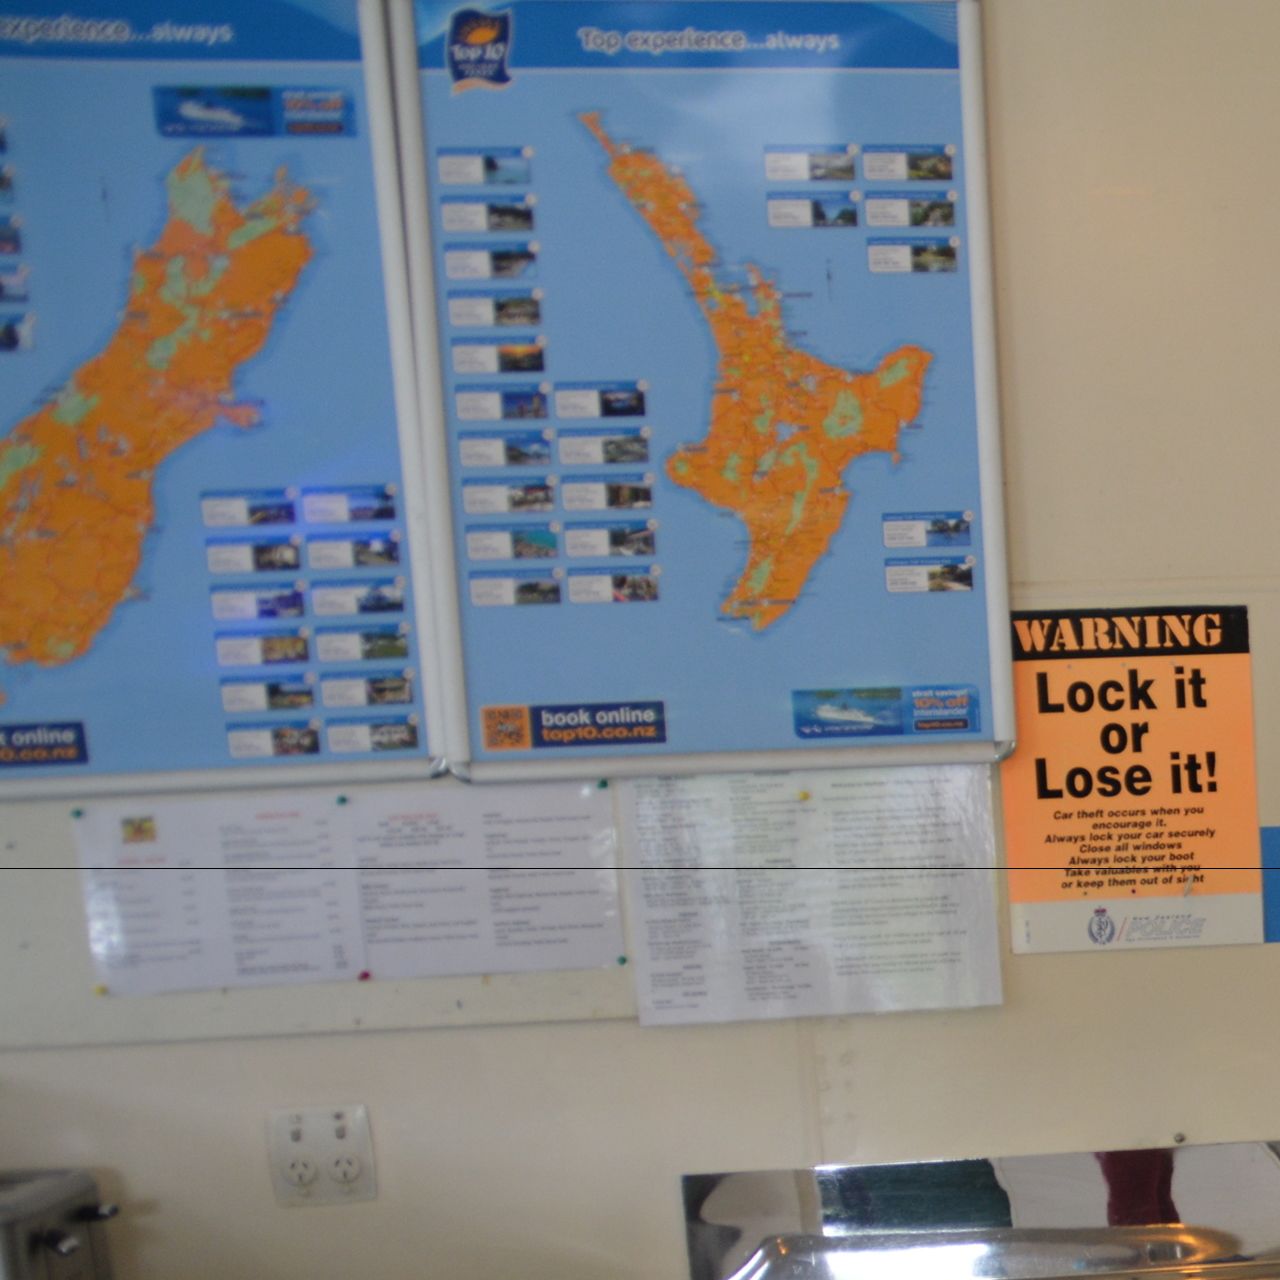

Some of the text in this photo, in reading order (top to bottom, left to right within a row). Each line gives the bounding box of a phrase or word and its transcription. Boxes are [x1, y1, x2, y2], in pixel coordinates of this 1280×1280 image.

[577, 26, 620, 54] Top
[1013, 613, 1222, 652] WARNING
[1036, 666, 1207, 714] Lock it
[541, 707, 656, 726] book online
[12, 727, 75, 746] online
[542, 725, 657, 743] top10.co.nz
[1100, 721, 1149, 755] or
[1035, 751, 1217, 799] Lose it!
[1053, 806, 1205, 820] Car theft occurs when you
[1091, 818, 1167, 830] encourage it.
[1044, 828, 1215, 844] Always lock your car securely
[1079, 841, 1182, 853] Close all windows
[1069, 852, 1195, 866] Always lock your boot
[1064, 864, 1201, 877] Take valuables with you
[1061, 874, 1205, 889] or keep them out of siht
[1128, 918, 1207, 937] POLICE
